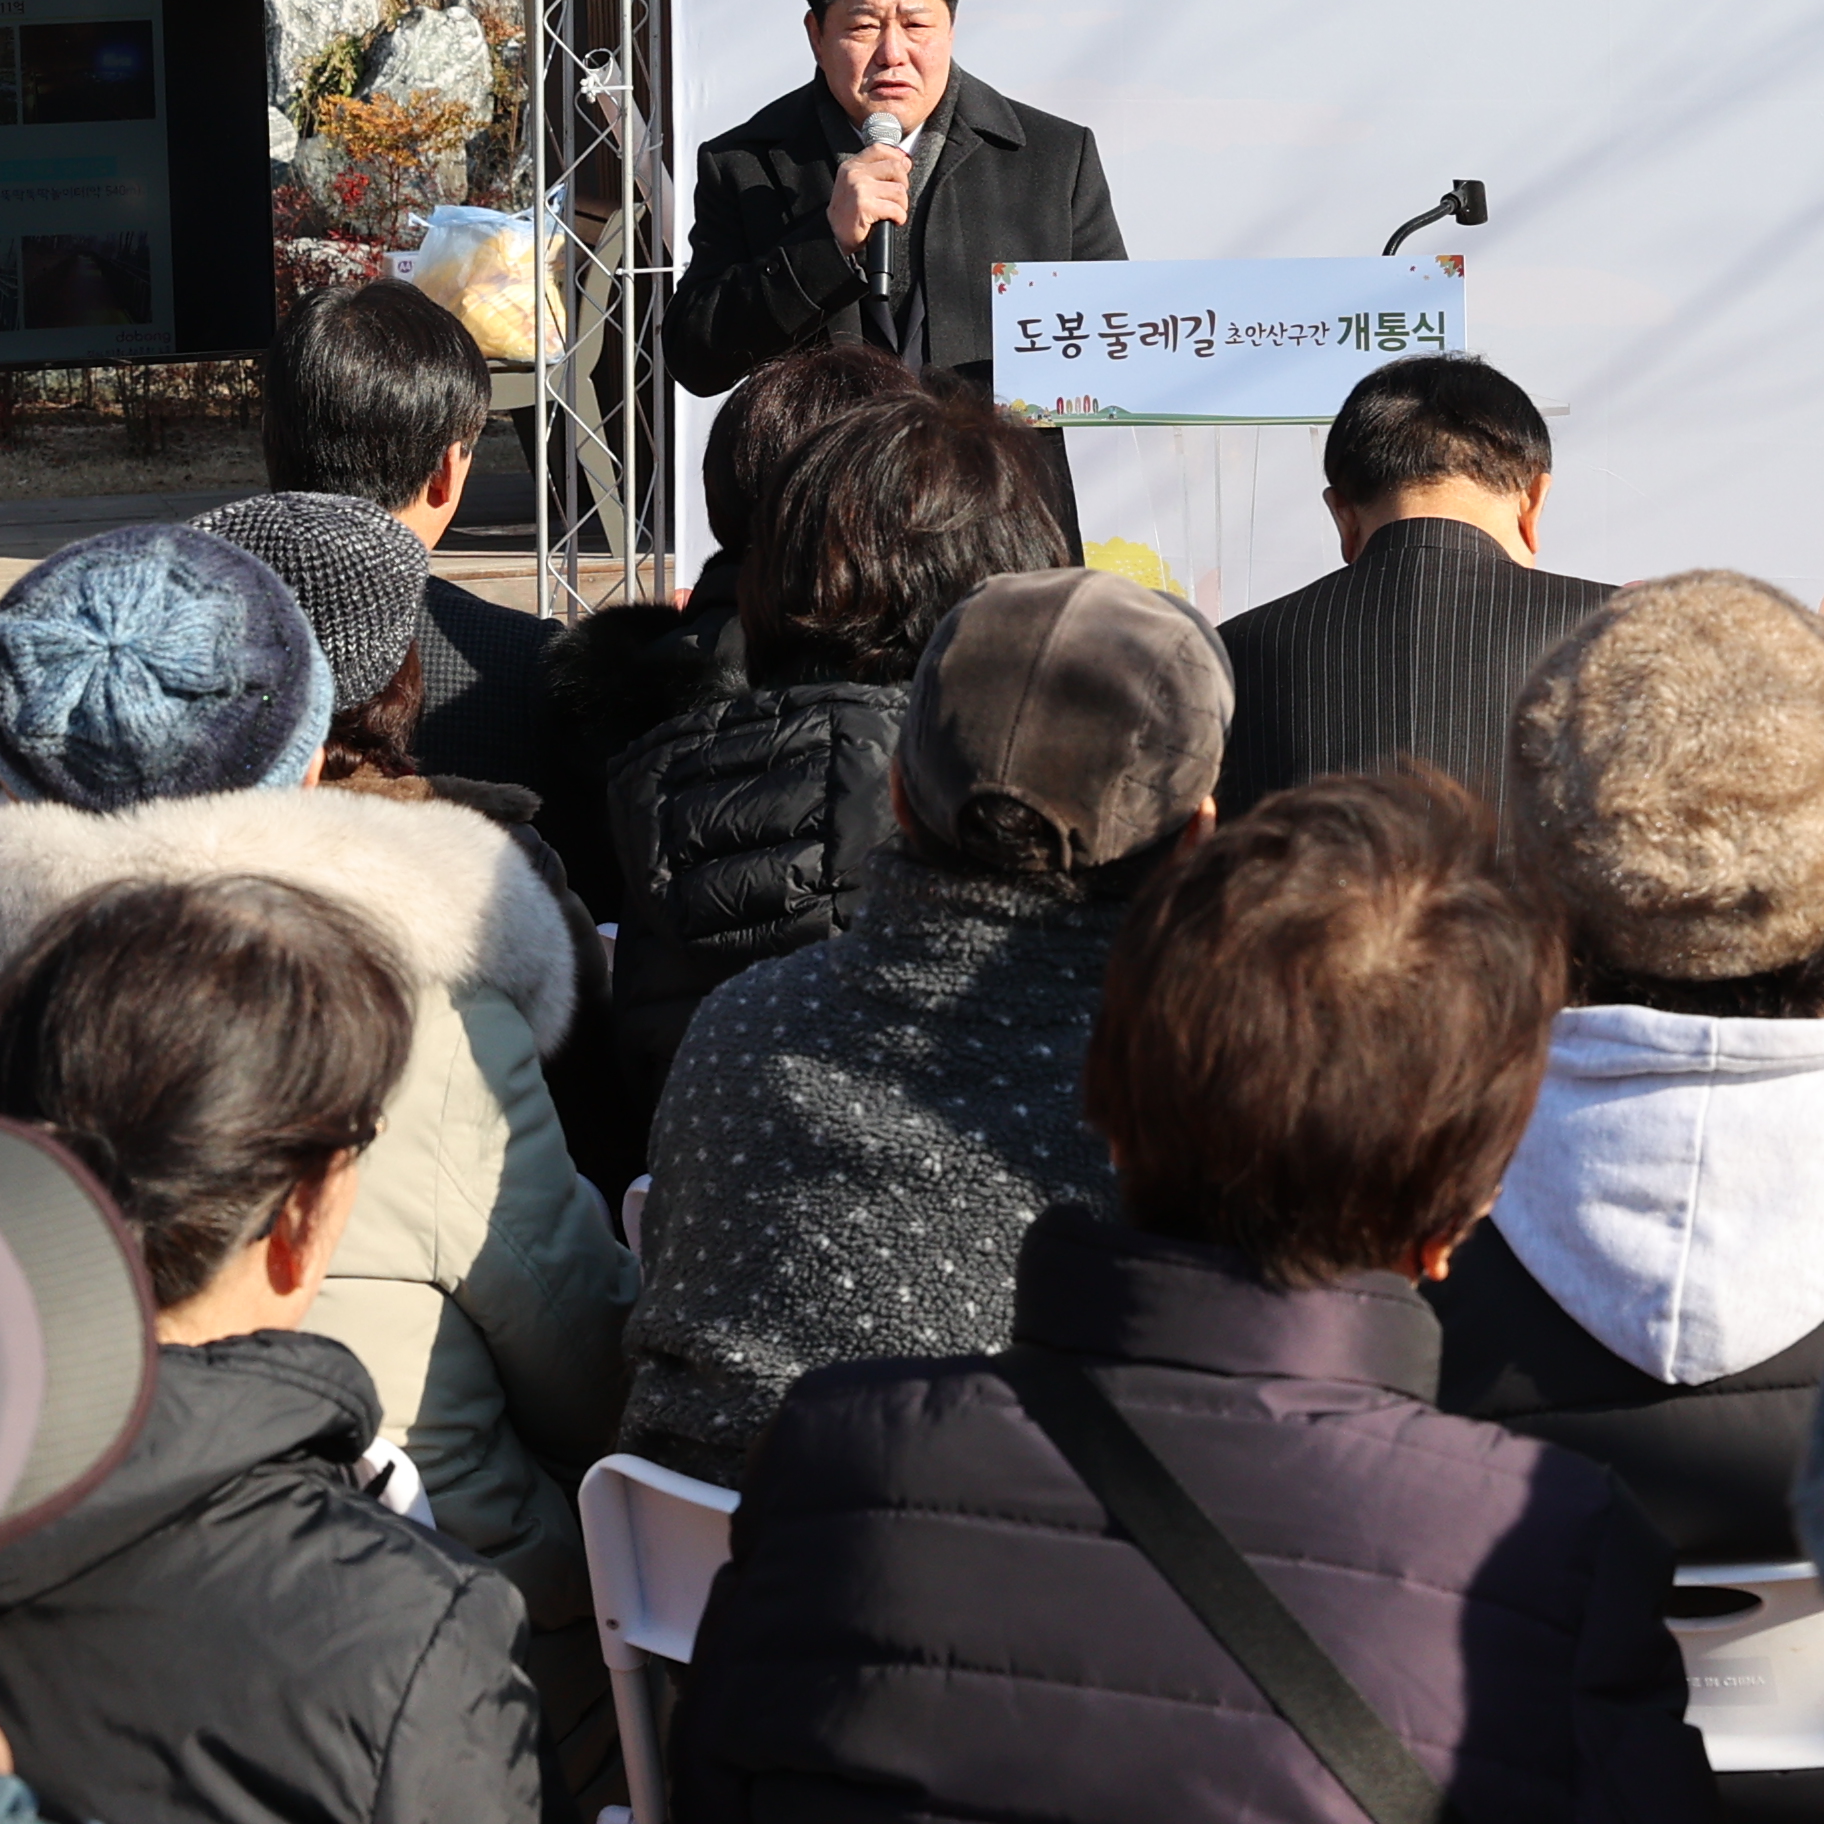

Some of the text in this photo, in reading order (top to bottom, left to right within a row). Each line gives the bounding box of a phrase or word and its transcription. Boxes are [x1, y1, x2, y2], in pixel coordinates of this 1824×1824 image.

[115, 330, 172, 344] dobong
[1014, 308, 1447, 360] 도봉 둘레길 초안산구간 개통식
